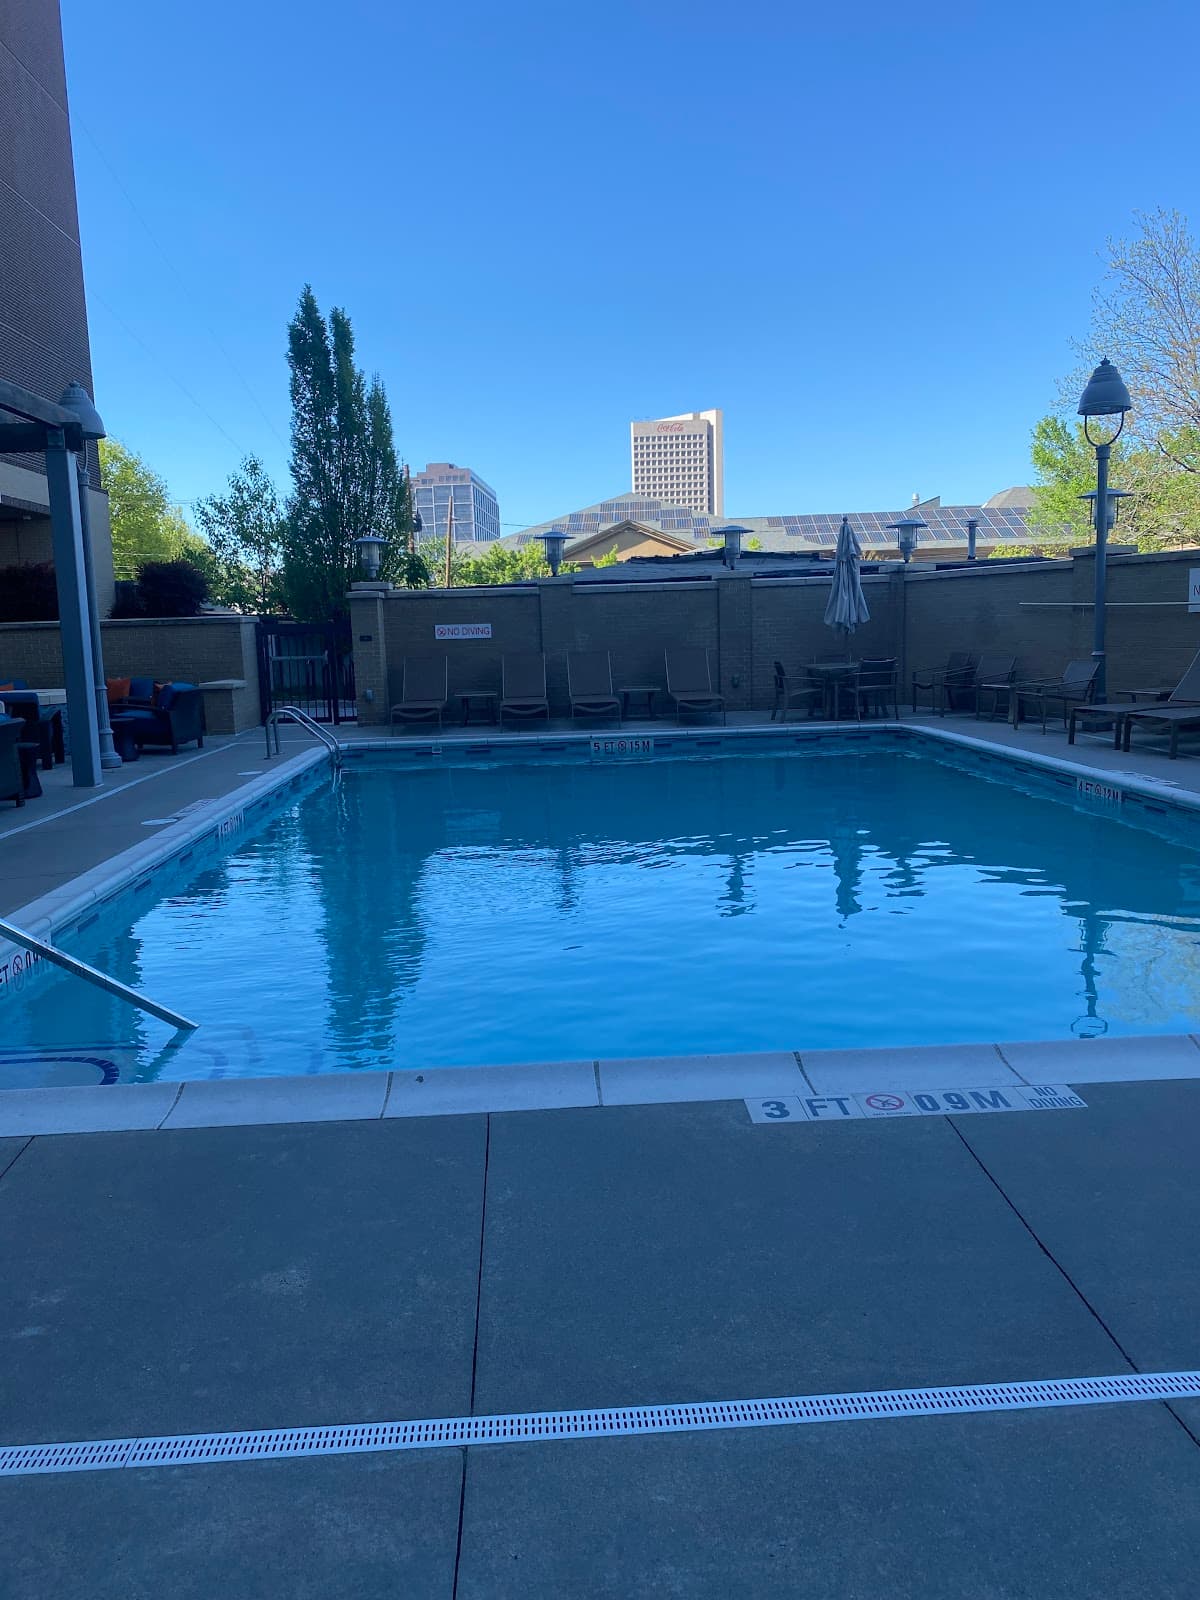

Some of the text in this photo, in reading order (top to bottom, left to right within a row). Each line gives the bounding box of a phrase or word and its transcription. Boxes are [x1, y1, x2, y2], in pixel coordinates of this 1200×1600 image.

[447, 626, 490, 636] NO DIVING
[1032, 1086, 1057, 1097] NO
[762, 1100, 790, 1119] 3
[805, 1097, 850, 1117] FT
[1028, 1096, 1082, 1109] DIVING
